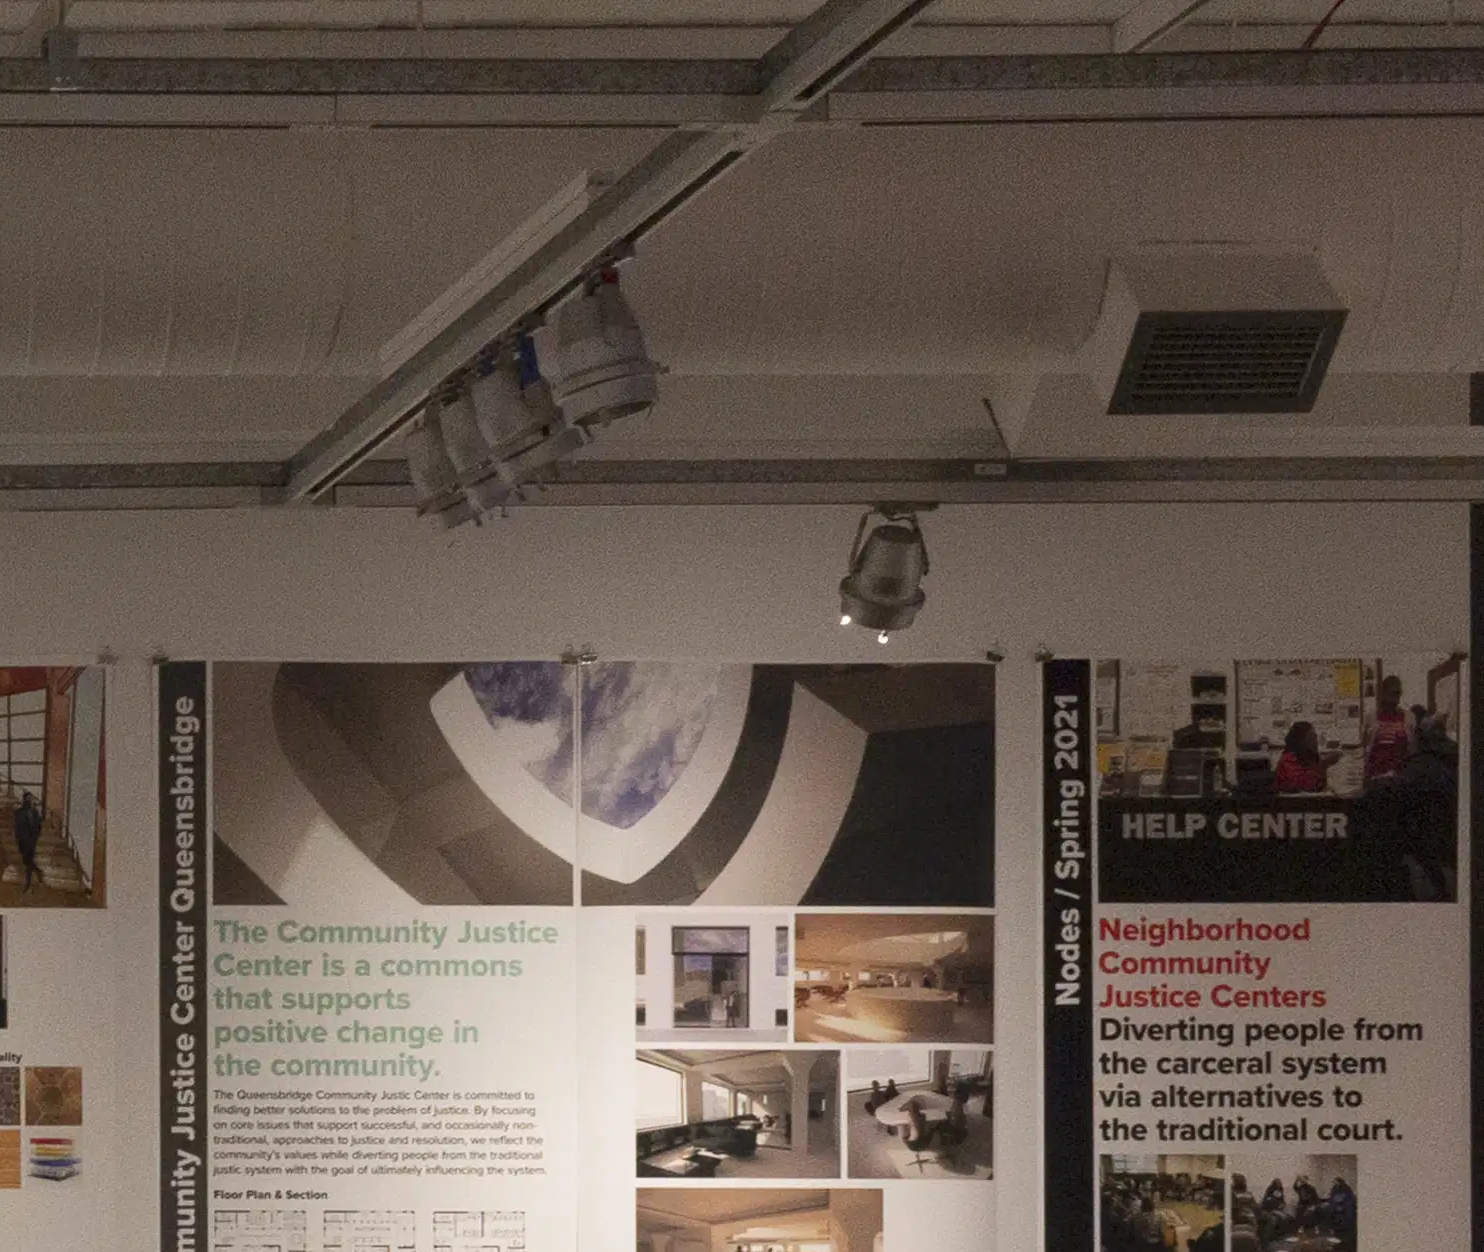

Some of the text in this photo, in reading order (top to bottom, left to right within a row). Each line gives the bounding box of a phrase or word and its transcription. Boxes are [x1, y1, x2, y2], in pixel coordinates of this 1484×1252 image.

[170, 698, 197, 912] Queensbridge
[1123, 814, 1346, 838] HELP CENTER
[1054, 696, 1084, 1005] Nodes / Spring 2021
[214, 920, 557, 949] The Community Justice
[1100, 918, 1309, 947] Neighborhood
[171, 922, 194, 1024] Center
[1099, 951, 1270, 980] Community
[213, 987, 409, 1015] that supports
[1100, 984, 1326, 1007] Justice Centers
[1101, 1017, 1422, 1047] Diverting people from
[214, 1053, 441, 1081] the community.
[170, 1034, 195, 1140] Justice
[1099, 1117, 1402, 1141] the traditional court.
[214, 1190, 327, 1199] Floor Plan & Section
